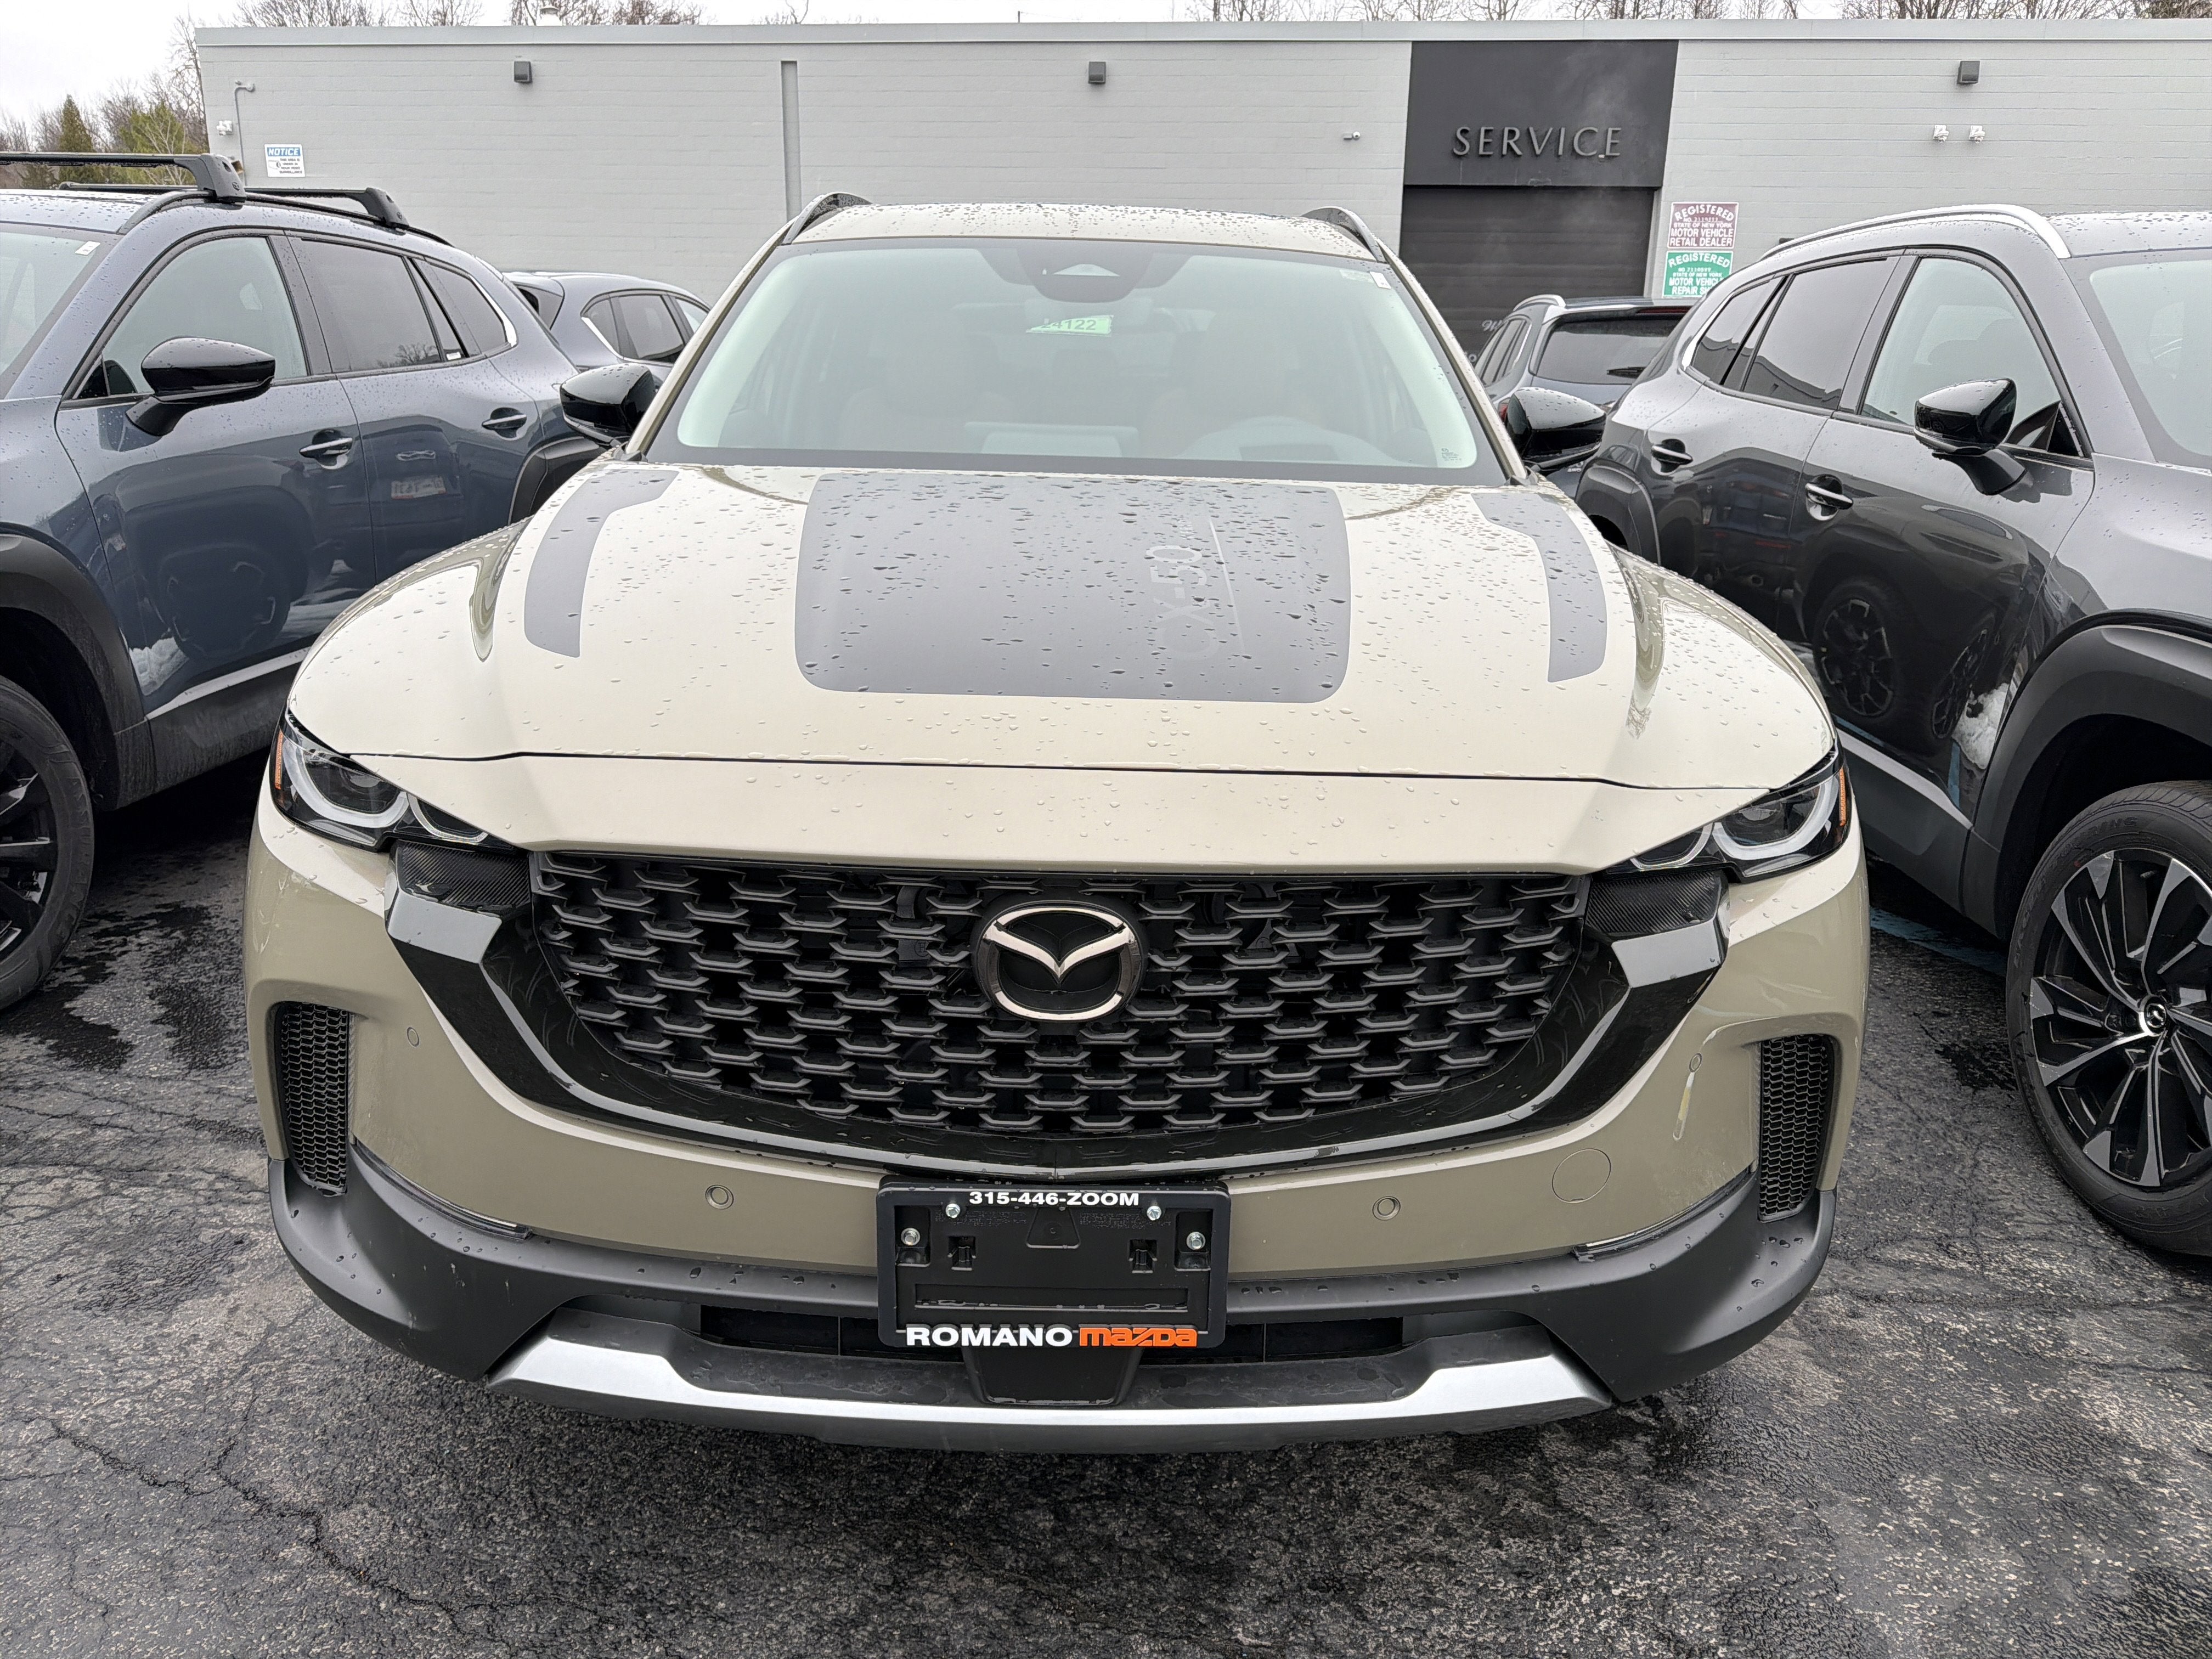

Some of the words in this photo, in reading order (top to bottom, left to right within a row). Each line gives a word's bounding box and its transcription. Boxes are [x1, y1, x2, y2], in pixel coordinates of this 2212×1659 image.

[1453, 126, 1622, 156] SERVICE
[1674, 204, 1734, 221] REGISTERED
[1671, 228, 1699, 237] MOTOR
[1701, 228, 1734, 237] VEHICLE
[1669, 237, 1697, 246] RETAIL
[1700, 237, 1733, 246] DEALER
[1668, 252, 1730, 268] REGISTERED
[1669, 277, 1694, 286] MOTOR
[1696, 278, 1723, 286] VEHICL
[1672, 286, 1698, 295] REPAIR
[1146, 545, 1221, 658] CX-50
[969, 1192, 1139, 1206] 315-446-ZOOM
[905, 1325, 1074, 1347] ROMANO
[1079, 1326, 1198, 1347] mazda
